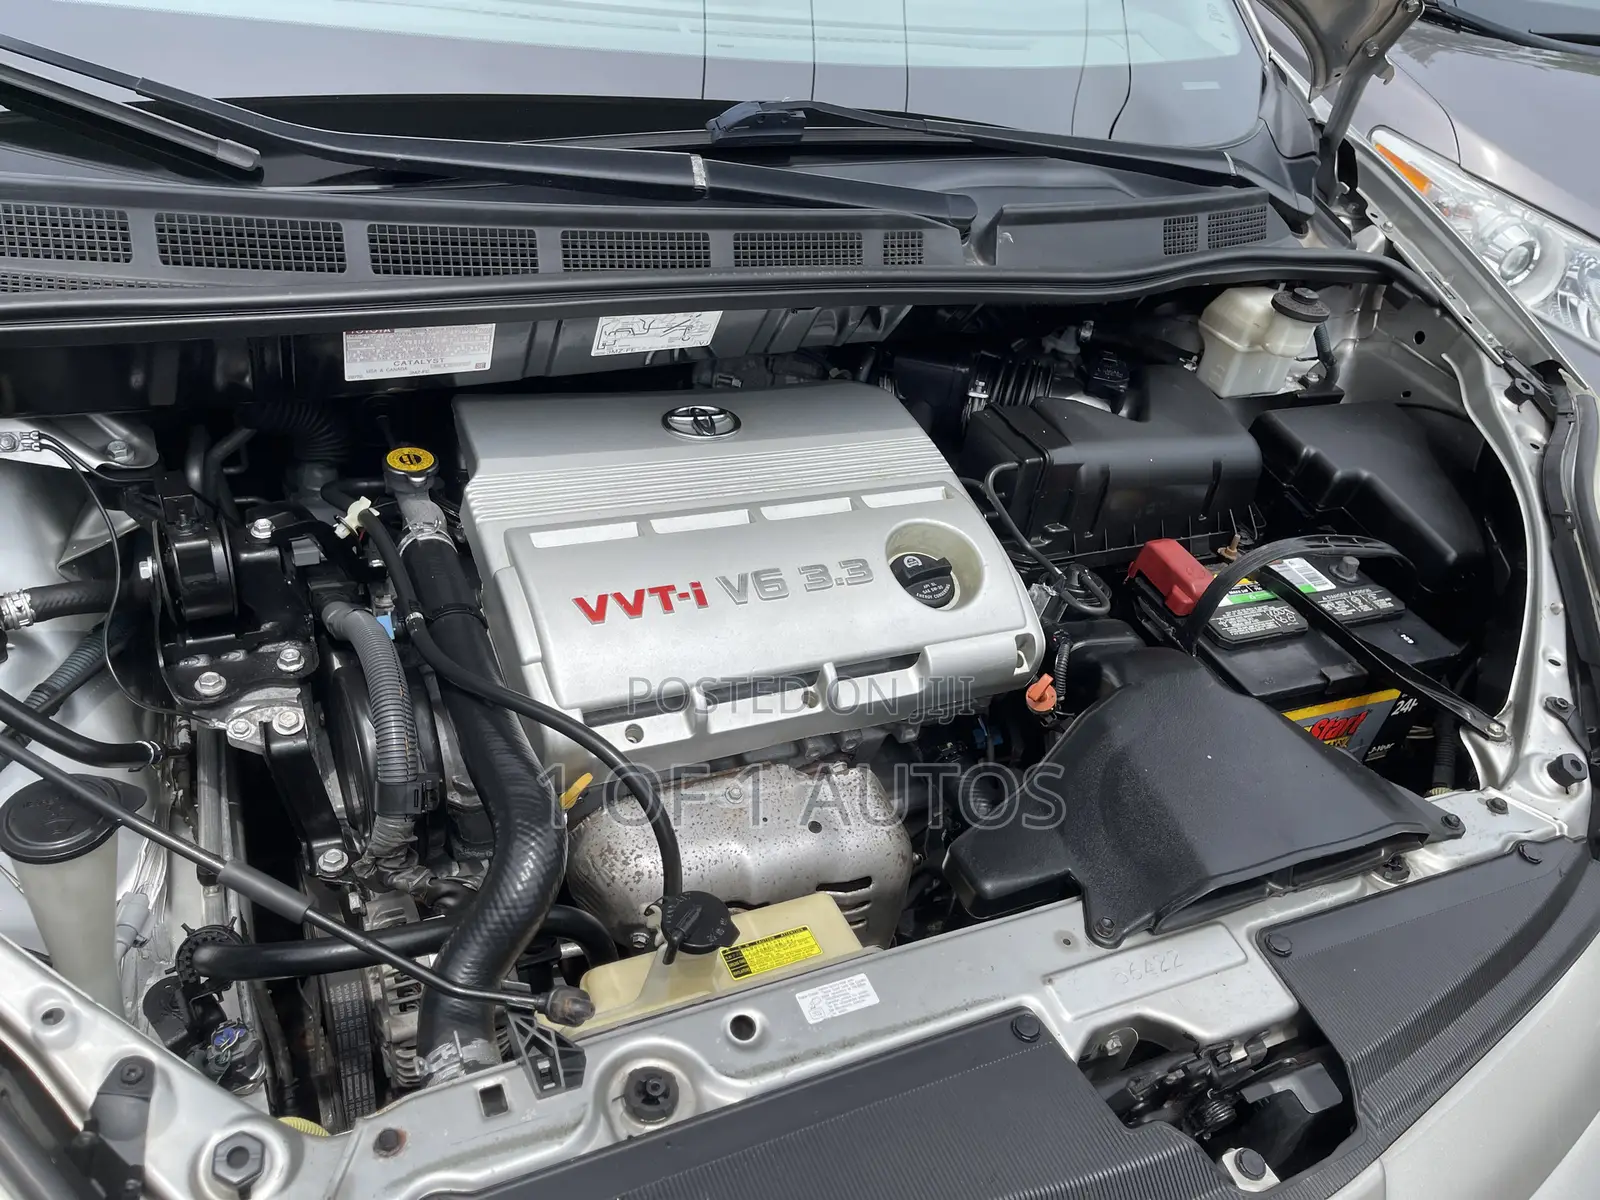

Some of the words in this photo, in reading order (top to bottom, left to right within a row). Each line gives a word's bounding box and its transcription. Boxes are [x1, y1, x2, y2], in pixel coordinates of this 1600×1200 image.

[393, 358, 445, 367] CATALYST
[571, 580, 710, 626] VVT-i
[714, 567, 790, 606] V6
[797, 557, 875, 593] 3.3
